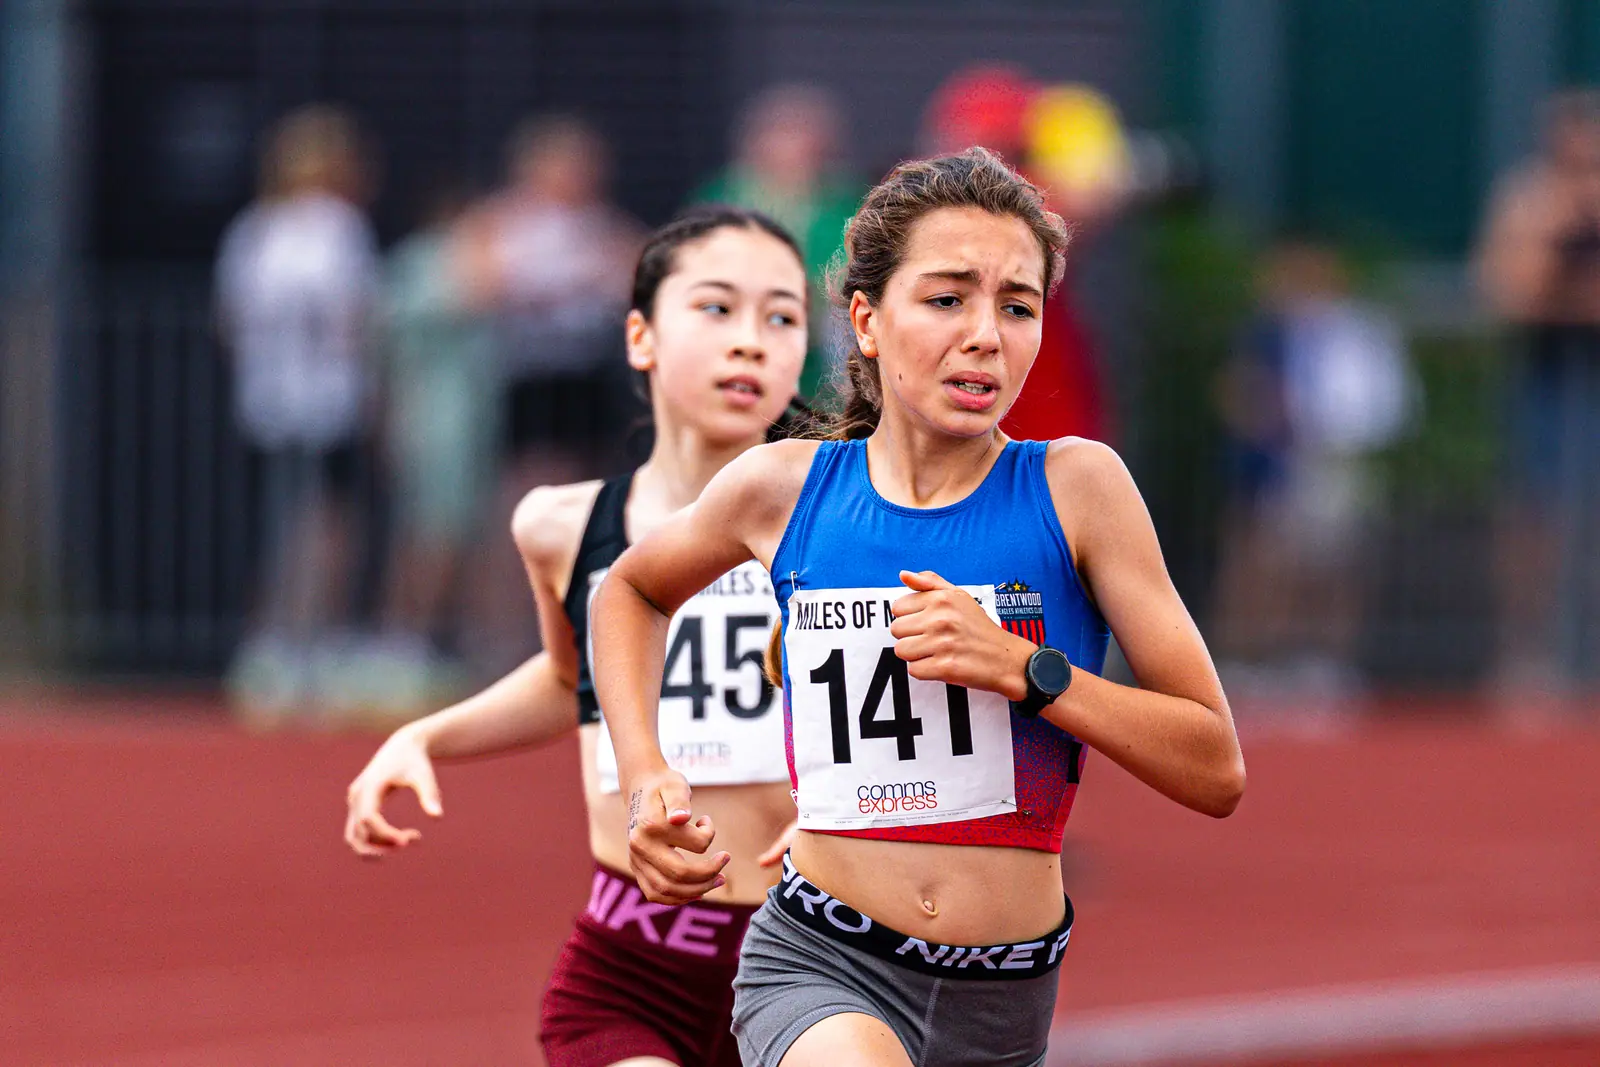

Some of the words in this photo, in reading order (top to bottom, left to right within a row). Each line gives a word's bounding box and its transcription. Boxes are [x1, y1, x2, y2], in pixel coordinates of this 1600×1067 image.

[995, 593, 1042, 607] BRENTWOOD
[795, 601, 847, 630] MILES
[852, 601, 877, 628] OF
[1015, 607, 1034, 615] ATHLETICS
[809, 646, 974, 764] 141
[857, 780, 937, 801] comms
[858, 793, 938, 814] express
[894, 937, 1045, 970] NIKE
